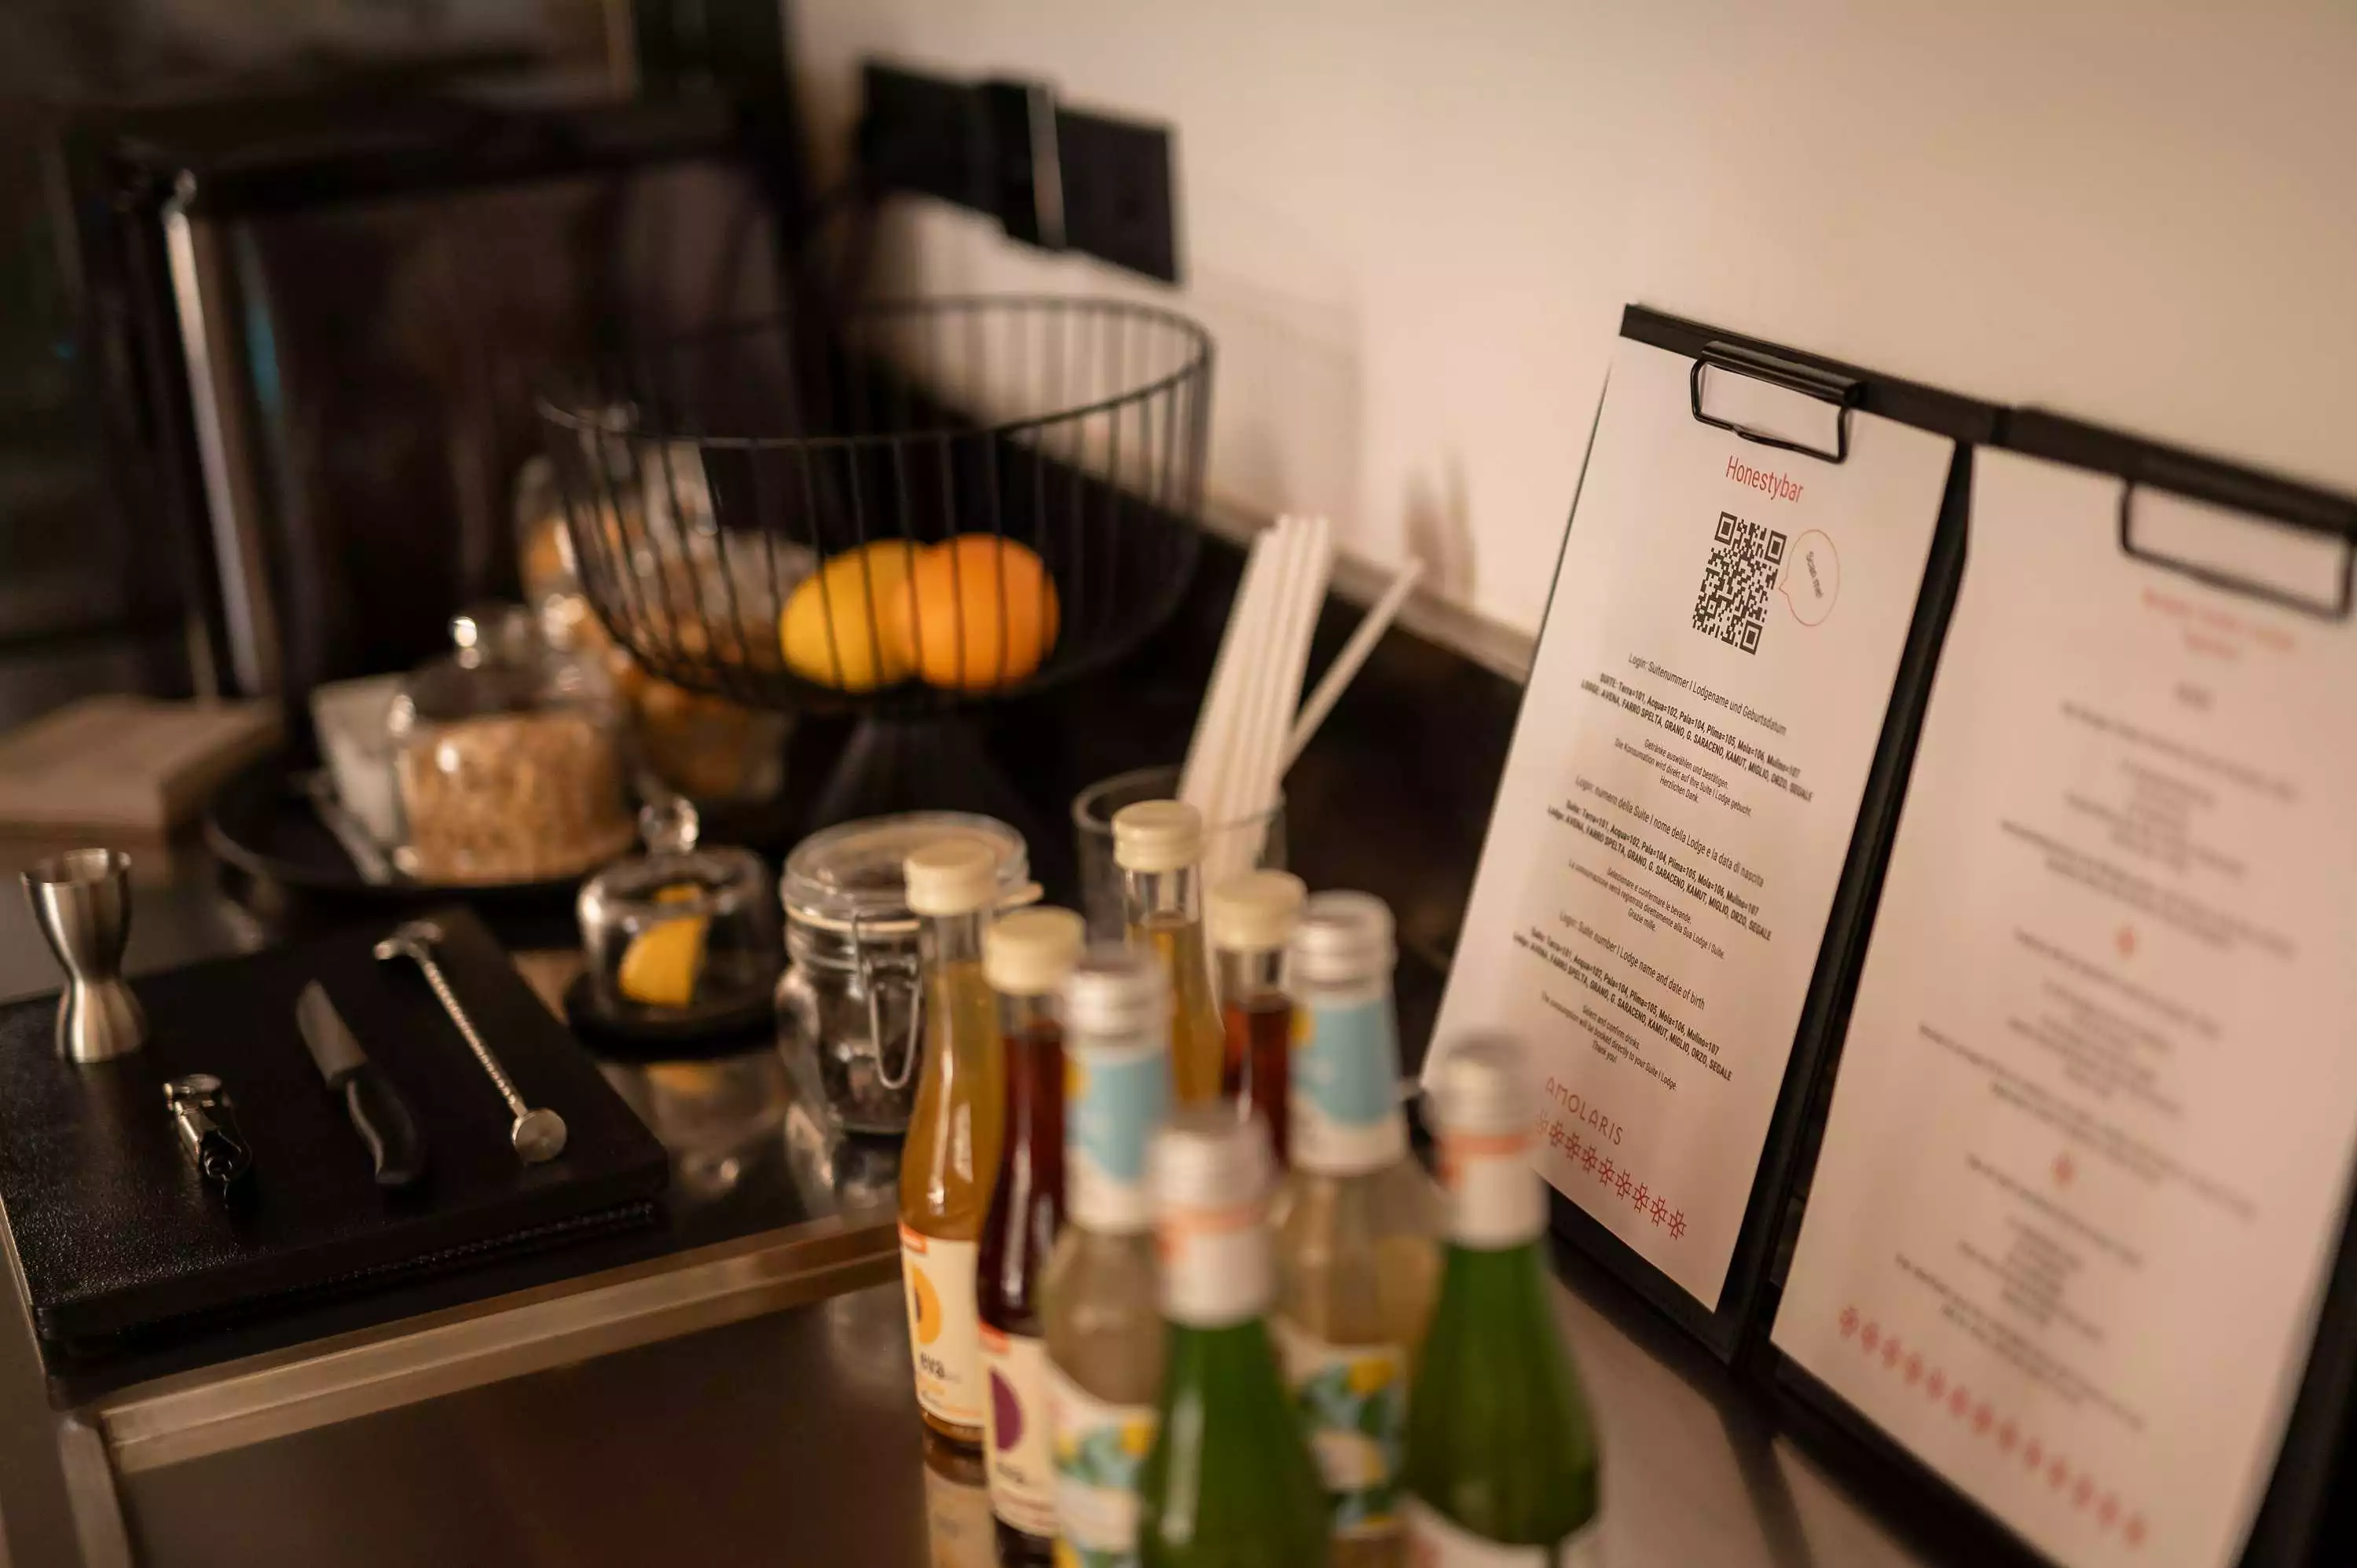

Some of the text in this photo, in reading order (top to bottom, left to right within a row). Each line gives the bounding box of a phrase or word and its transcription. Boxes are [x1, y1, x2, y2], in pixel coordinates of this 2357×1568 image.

[1725, 455, 1803, 502] Honestybar
[1628, 652, 1648, 669] Login:
[1648, 661, 1689, 688] Suitenummer
[1692, 681, 1729, 708] Lodgename
[1729, 701, 1743, 714] und
[1743, 705, 1787, 735] Geburtsdatum
[1622, 698, 1641, 715] FARRO
[1640, 708, 1663, 728] SPELTA,
[1664, 719, 1685, 738] GRANO,
[1686, 730, 1692, 742] G.
[1693, 733, 1725, 759] SARACENO,
[1725, 749, 1747, 771] KAMUT,
[1748, 761, 1769, 782] MIGLIO,
[1647, 695, 1678, 720] Acqua=102,
[1679, 710, 1705, 733] Pala=104,
[1706, 724, 1736, 749] Plima=105,
[1655, 760, 1666, 771] wird
[1666, 764, 1681, 779] direkt
[1681, 771, 1690, 783] auf
[1690, 775, 1699, 789] Ihre
[1699, 782, 1714, 796] Suite
[1715, 789, 1730, 806] Lodge
[1659, 775, 1685, 796] Herzlichen
[1692, 762, 1702, 775] und
[1610, 824, 1640, 850] Acqua=102,
[1641, 841, 1667, 865] Pala=104,
[1667, 856, 1697, 882] Plima=105,
[1697, 873, 1725, 899] Mola=106,
[1618, 797, 1633, 814] della
[1633, 805, 1649, 823] Suite
[1654, 817, 1670, 835] nome
[1671, 826, 1686, 843] della
[1687, 834, 1706, 855] Lodge
[1706, 848, 1711, 857] e
[1711, 848, 1718, 861] la
[1718, 853, 1732, 870] data
[1733, 861, 1741, 874] di
[1604, 836, 1626, 857] SPELTA,
[1627, 849, 1648, 870] GRANO,
[1648, 861, 1655, 872] G.
[1655, 865, 1685, 893] SARACENO,
[1686, 883, 1707, 906] KAMUT,
[1708, 897, 1729, 918] MIGLIO,
[1730, 909, 1747, 930] ORZO,
[1638, 886, 1666, 907] confermare
[1665, 900, 1670, 911] le
[1628, 907, 1643, 924] Grazie
[1673, 921, 1683, 933] alla
[1682, 926, 1692, 939] Sua
[1692, 932, 1707, 949] Lodge
[1593, 932, 1617, 953] number
[1619, 947, 1639, 968] Lodge
[1639, 961, 1656, 978] name
[1656, 973, 1669, 987] and
[1668, 978, 1683, 996] date
[1682, 989, 1692, 1000] of
[1690, 993, 1705, 1011] birth
[1589, 980, 1610, 1002] GRANO,
[1610, 993, 1616, 1005] G.
[1617, 998, 1647, 1027] SARACENO,
[1648, 1017, 1669, 1042] KAMUT,
[1669, 1032, 1690, 1056] MIGLIO,
[1691, 1047, 1708, 1068] ORZO,
[1709, 1059, 1732, 1082] SEGALE
[1604, 973, 1629, 998] Pala=104,
[1629, 989, 1658, 1019] Plima=105,
[1659, 1009, 1686, 1037] Mola=106,
[1687, 1027, 1720, 1056] Mulino=107
[1607, 1021, 1625, 1040] confirm
[1629, 1050, 1635, 1061] to
[1634, 1055, 1646, 1069] your
[1645, 1062, 1659, 1078] Suite
[1660, 1072, 1678, 1092] Lodge.
[1545, 1077, 1623, 1145] AMOLARIS
